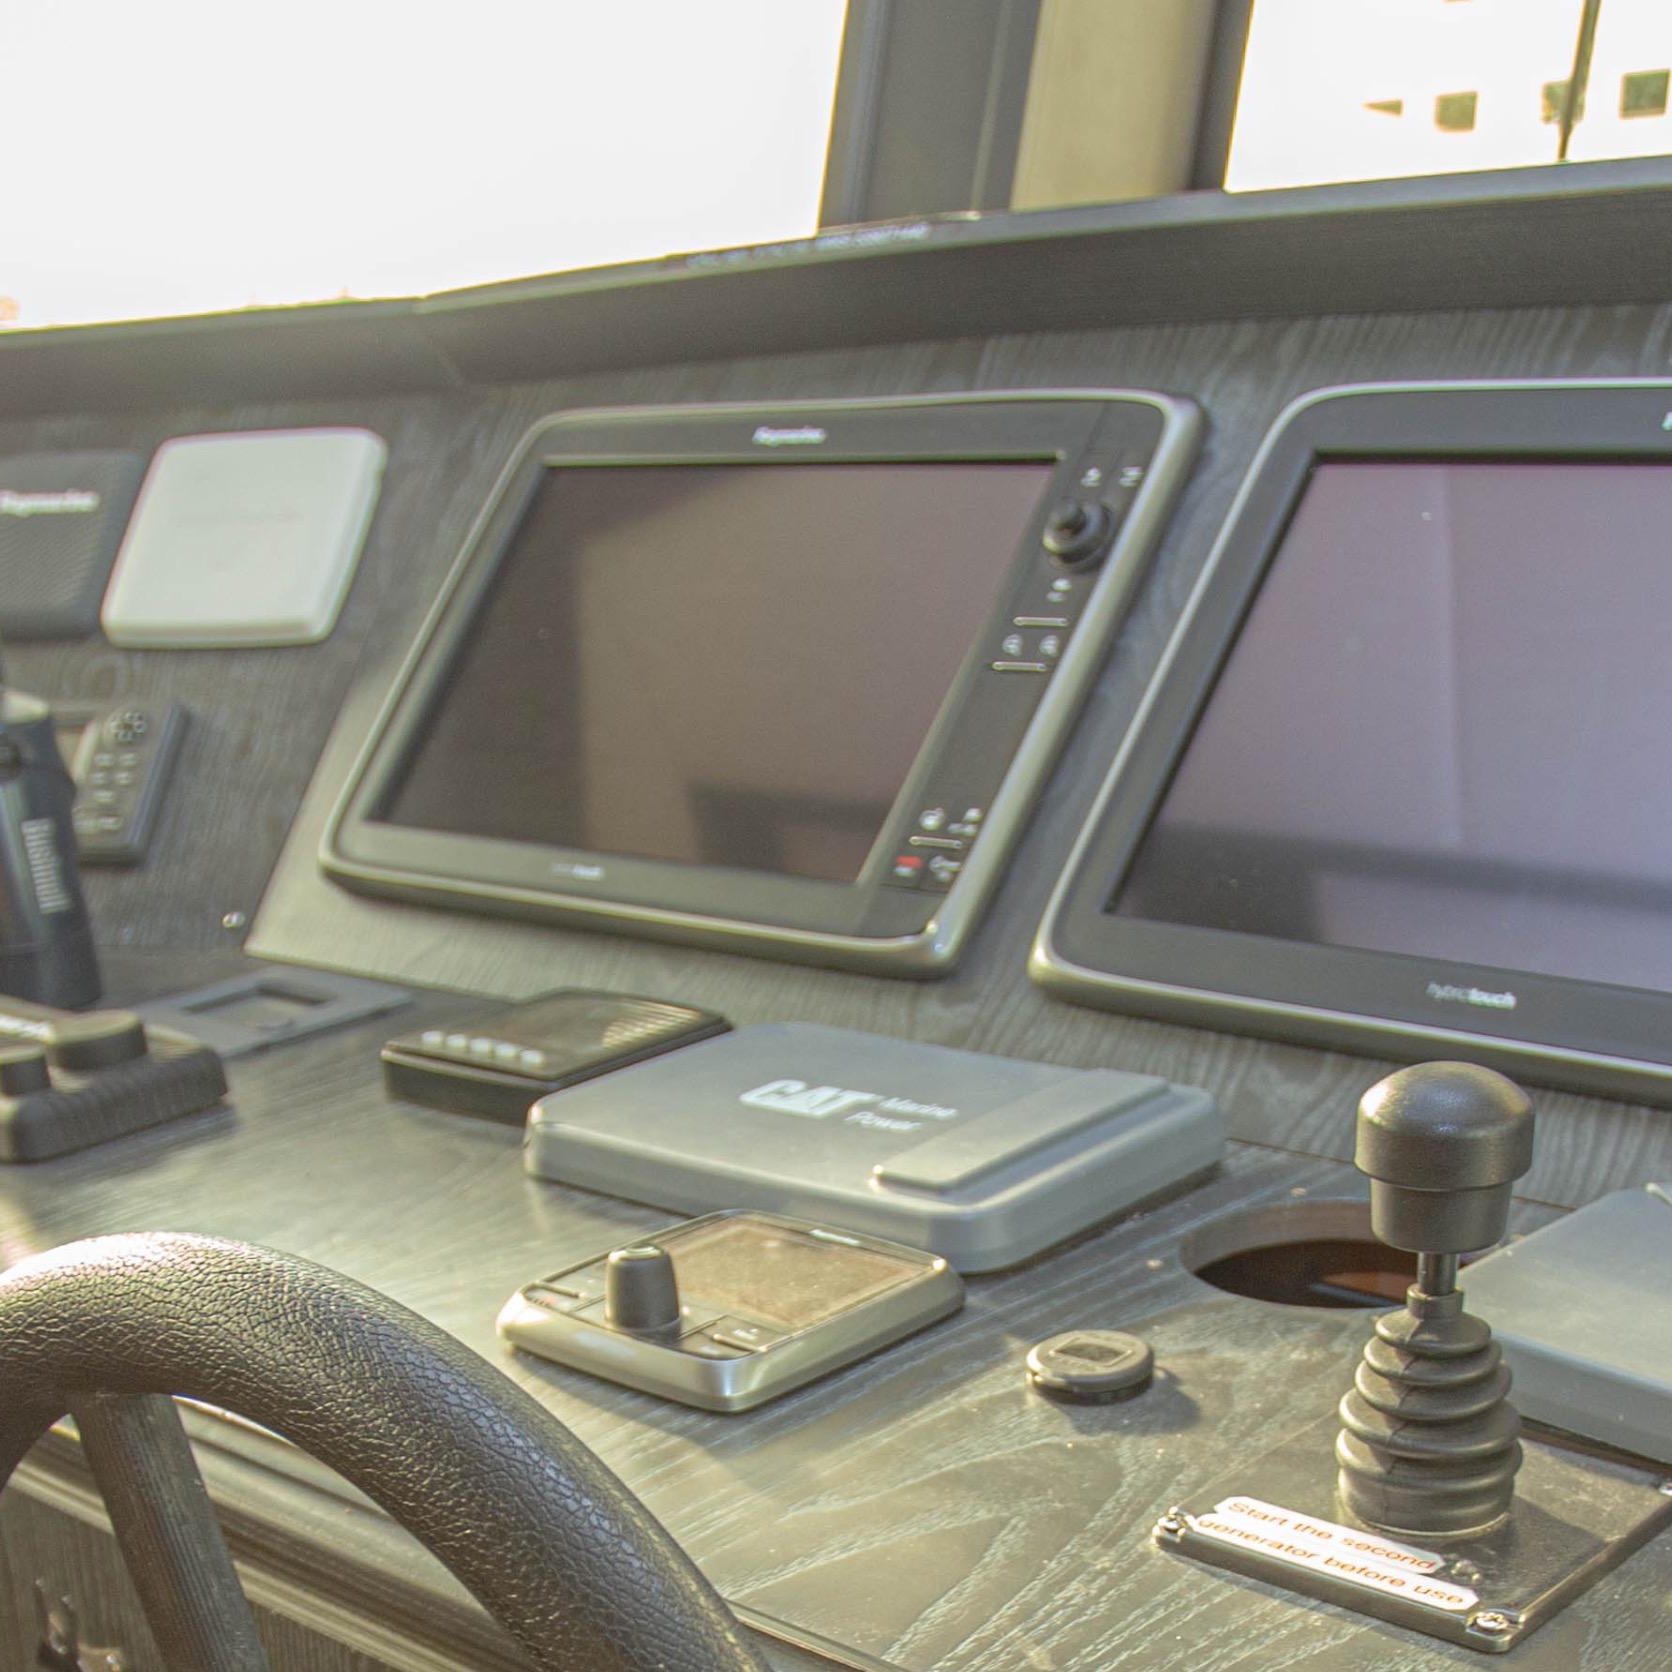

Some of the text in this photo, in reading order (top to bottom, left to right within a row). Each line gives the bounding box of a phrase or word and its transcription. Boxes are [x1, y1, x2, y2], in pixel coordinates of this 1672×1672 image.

[739, 1078, 884, 1118] CAT
[1197, 1517, 1465, 1605] generator before use
[1229, 1501, 1436, 1571] Start the second
